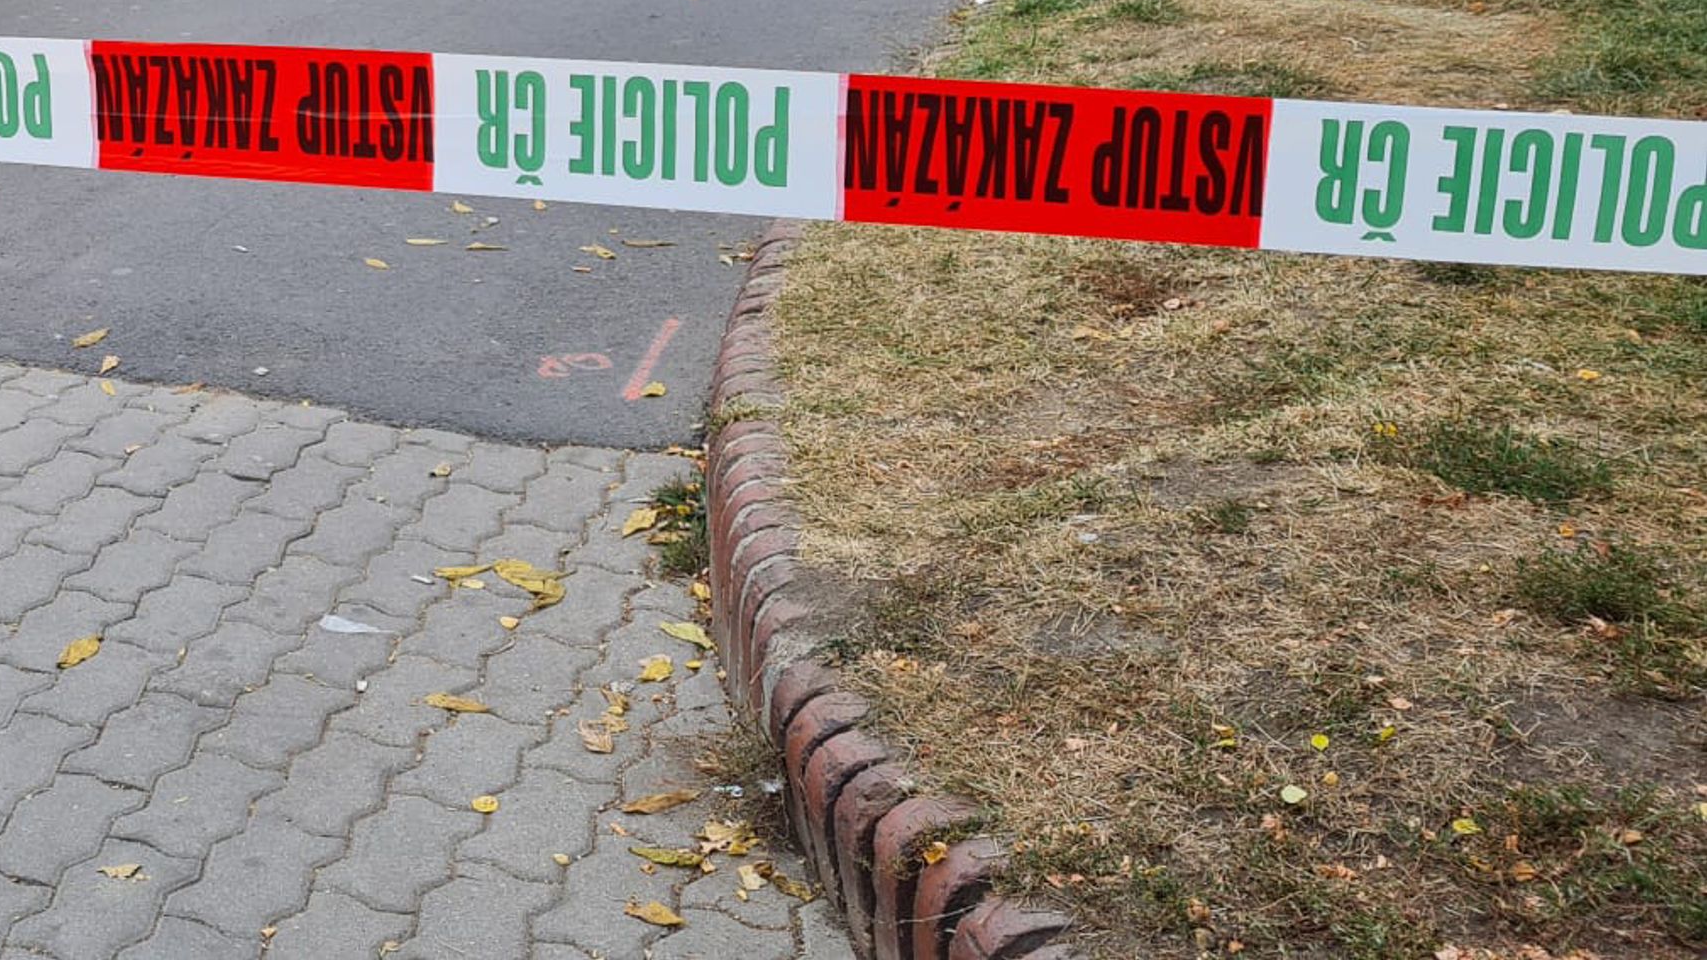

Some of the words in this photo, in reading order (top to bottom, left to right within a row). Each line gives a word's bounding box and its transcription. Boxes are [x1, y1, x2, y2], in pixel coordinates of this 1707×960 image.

[92, 54, 280, 161] ZAKÁZÁN
[296, 60, 435, 164] VSTUP
[475, 68, 547, 187] ČR
[569, 73, 791, 188] POLICIE
[844, 89, 1075, 212] ZAKÁZÁN
[1090, 105, 1264, 218] VSTUP
[1314, 117, 1412, 243] ČR
